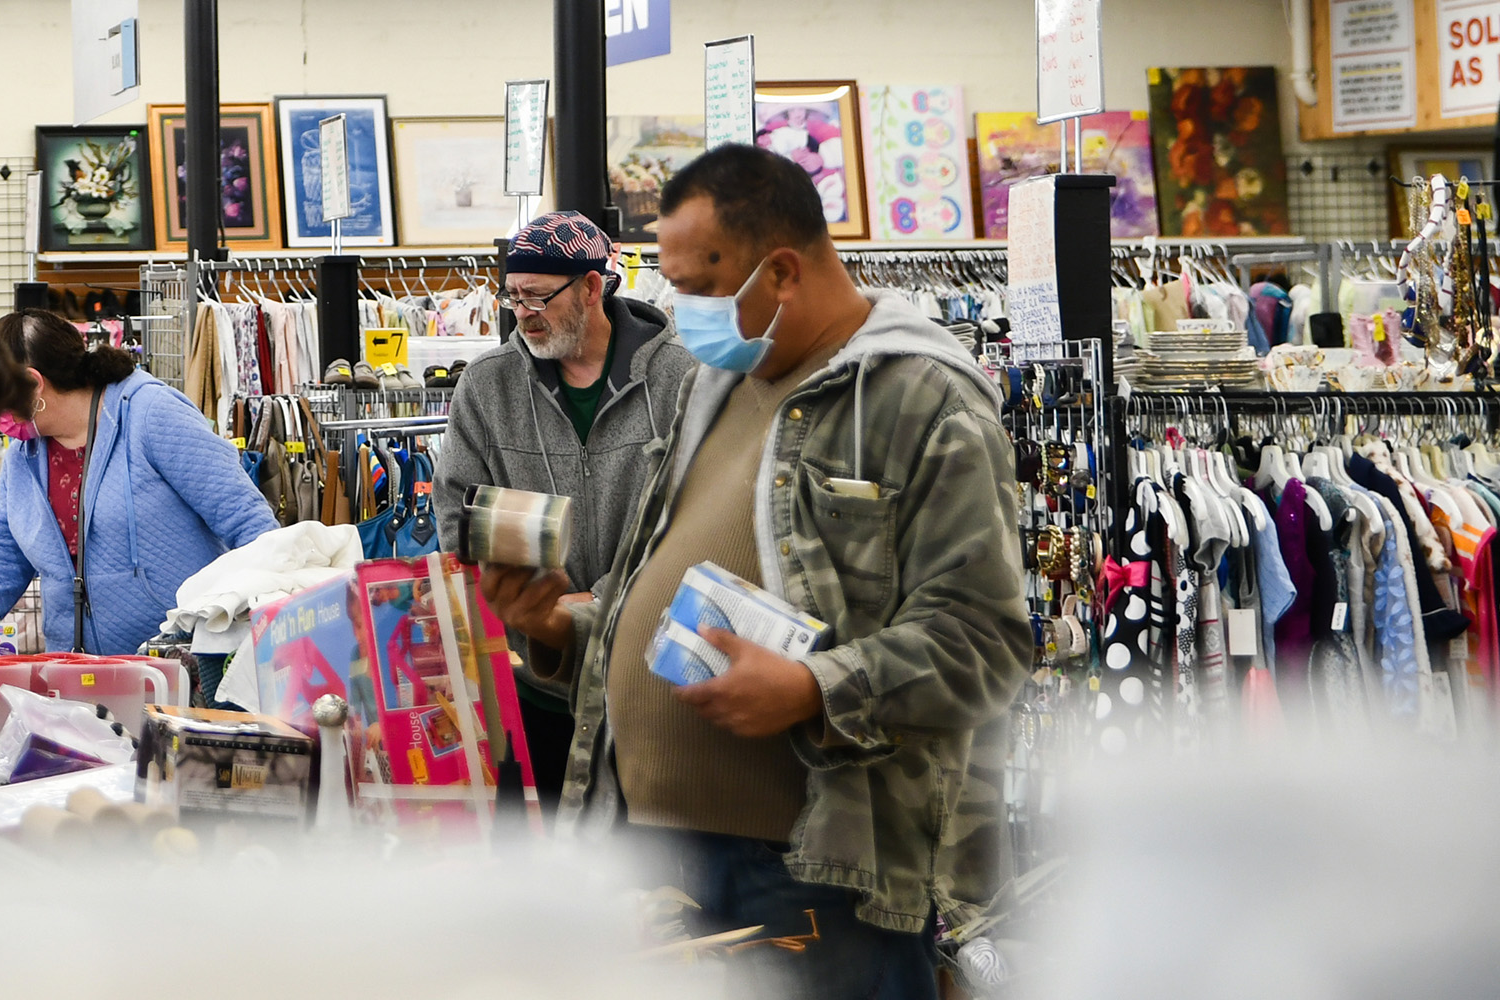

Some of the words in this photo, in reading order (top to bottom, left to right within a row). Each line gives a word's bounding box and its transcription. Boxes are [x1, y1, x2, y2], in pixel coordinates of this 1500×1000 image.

[1451, 56, 1483, 88] AS
[391, 333, 404, 358] 7
[297, 606, 316, 634] Fun
[317, 600, 341, 625] House
[409, 711, 423, 750] House
